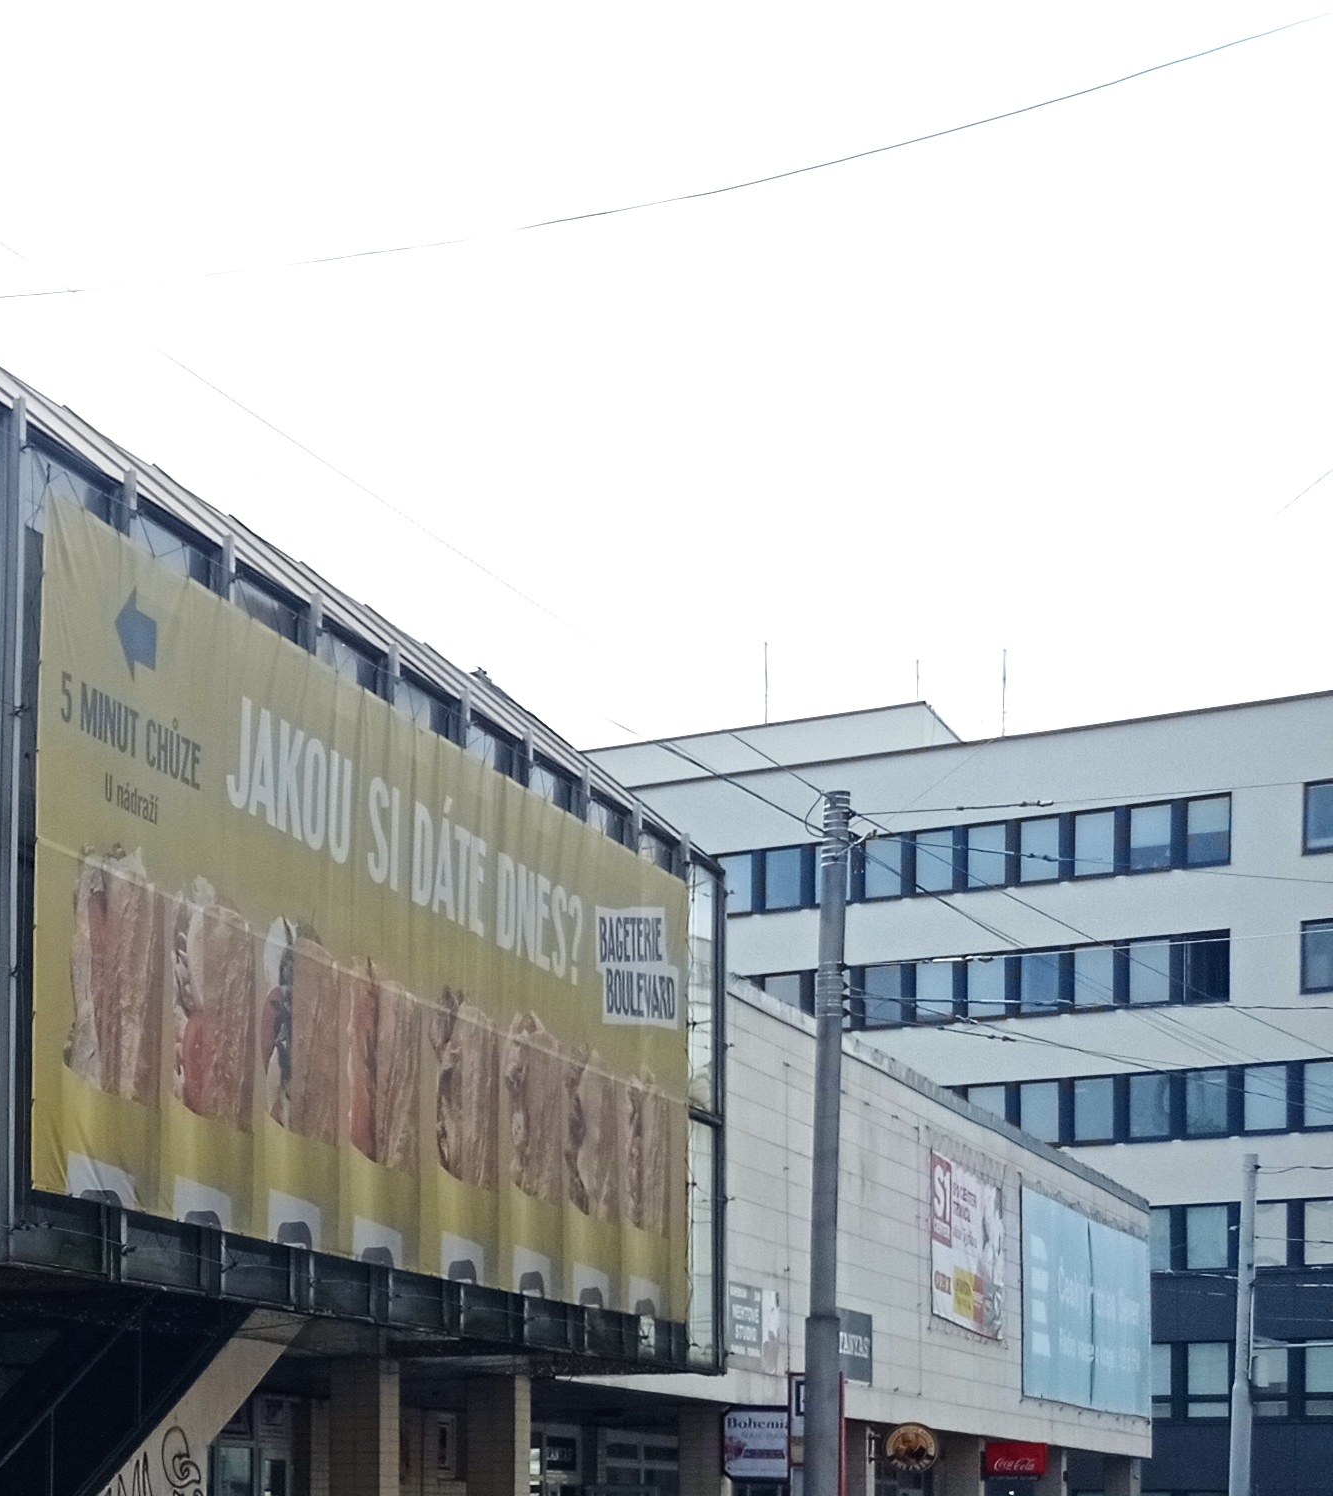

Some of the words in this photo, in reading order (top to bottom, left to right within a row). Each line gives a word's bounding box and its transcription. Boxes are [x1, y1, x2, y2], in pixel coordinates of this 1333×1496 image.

[61, 671, 73, 723] 5
[81, 681, 140, 758] MINUT
[146, 717, 202, 791] CHŮZE
[104, 773, 113, 803] U
[116, 781, 159, 826] nádraží
[226, 695, 352, 864] JAKOU
[368, 776, 401, 892] SI
[411, 796, 487, 939] DÁTE
[495, 852, 583, 986] DNES?
[598, 915, 663, 964] BAGETERIE
[605, 967, 676, 1020] BOULEVARD
